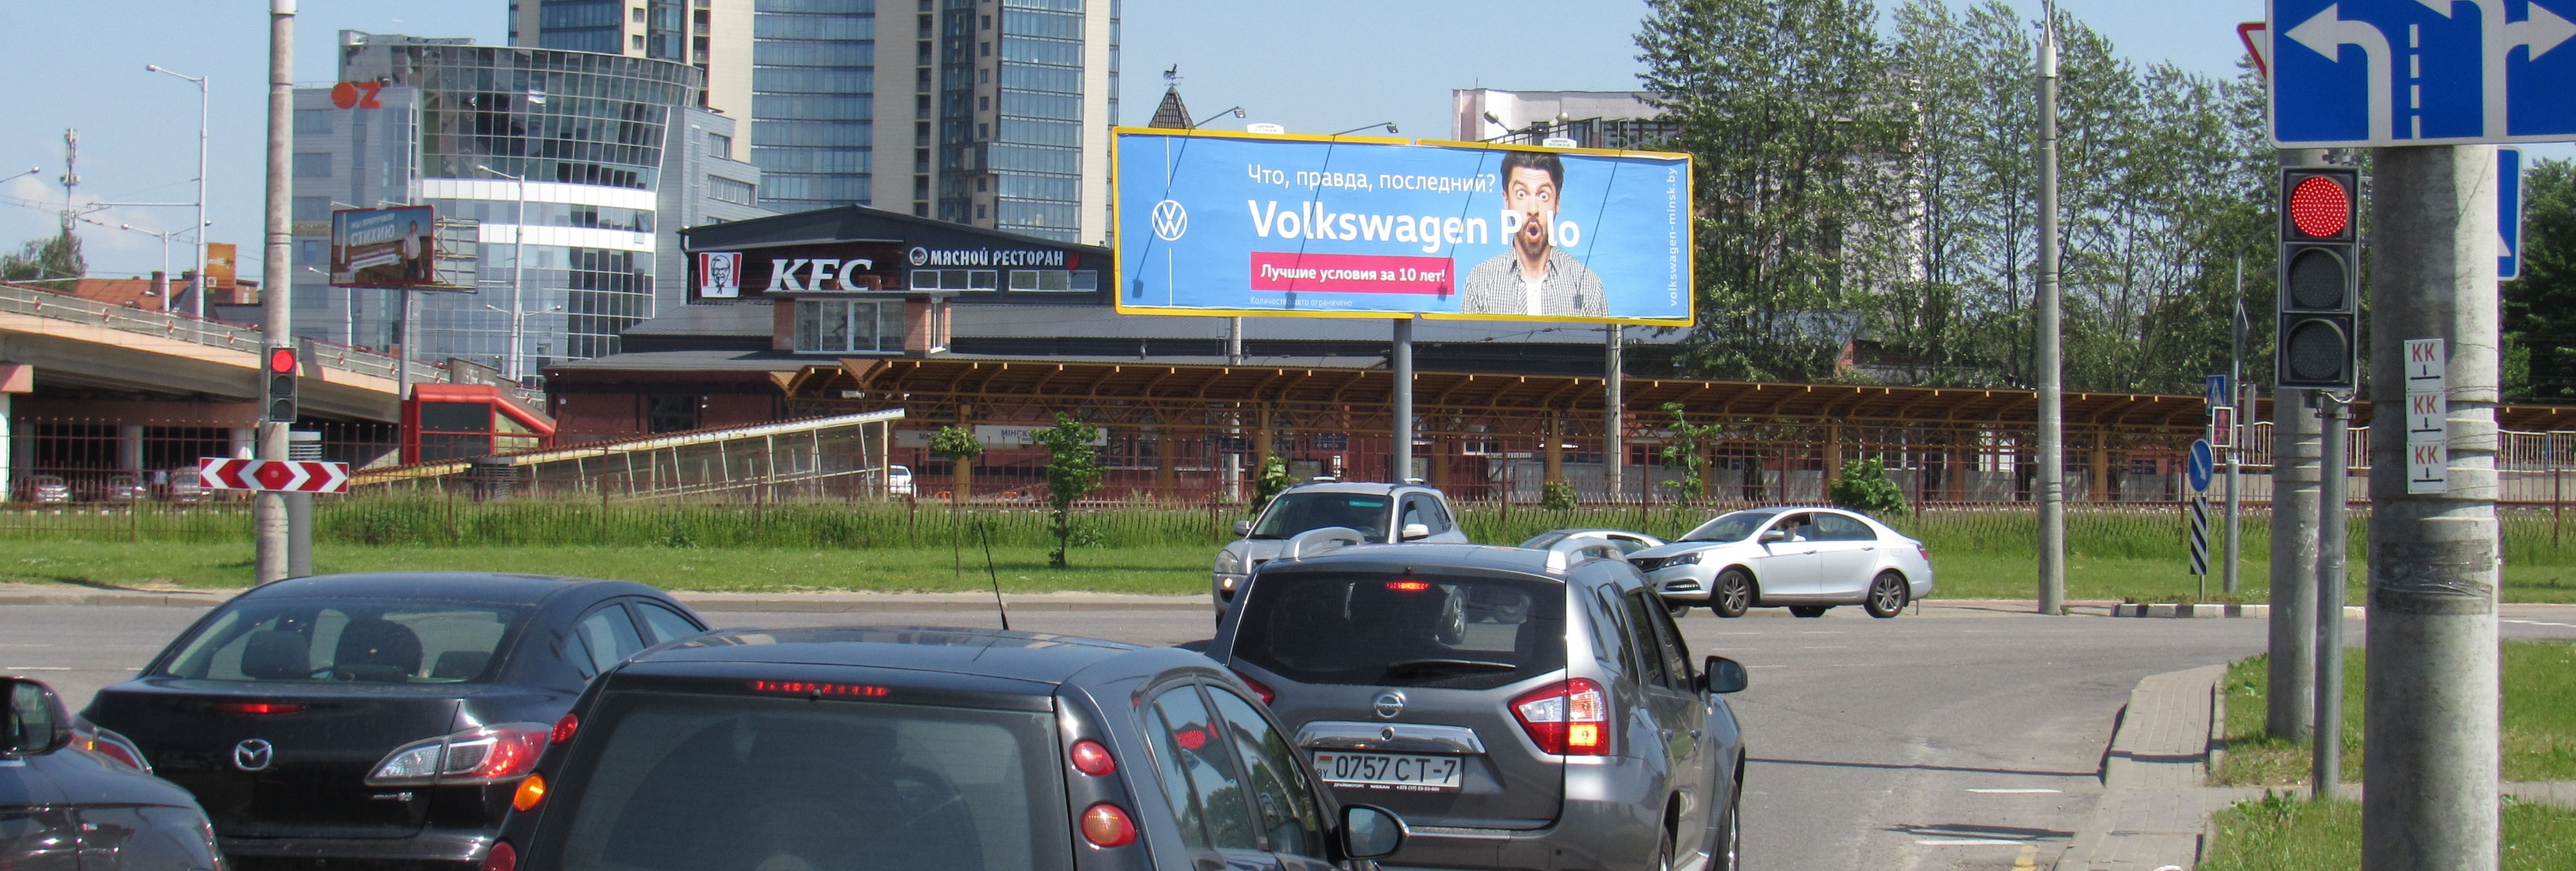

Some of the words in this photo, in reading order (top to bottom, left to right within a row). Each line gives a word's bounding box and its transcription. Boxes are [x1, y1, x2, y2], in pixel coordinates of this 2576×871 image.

[331, 81, 382, 110] OZ
[1248, 163, 1289, 189] Что,
[1296, 170, 1373, 192] правда,
[1379, 172, 1496, 195] последний?
[351, 224, 395, 247] СТИХИЮ
[1248, 200, 1488, 253] Volkswagen
[1500, 209, 1580, 248] Plo
[1666, 167, 1679, 307] volkswagen-minsk.by
[930, 247, 989, 266] МЯСНОЙ
[993, 250, 1063, 266] РЕСТОРАН
[766, 259, 873, 291] KFC
[1260, 264, 1317, 281] Лучшие
[1319, 268, 1376, 283] условия
[1380, 270, 1395, 281] за
[1399, 268, 1416, 281] 10
[1419, 269, 1446, 283] лет!
[1336, 755, 1390, 780] 0757
